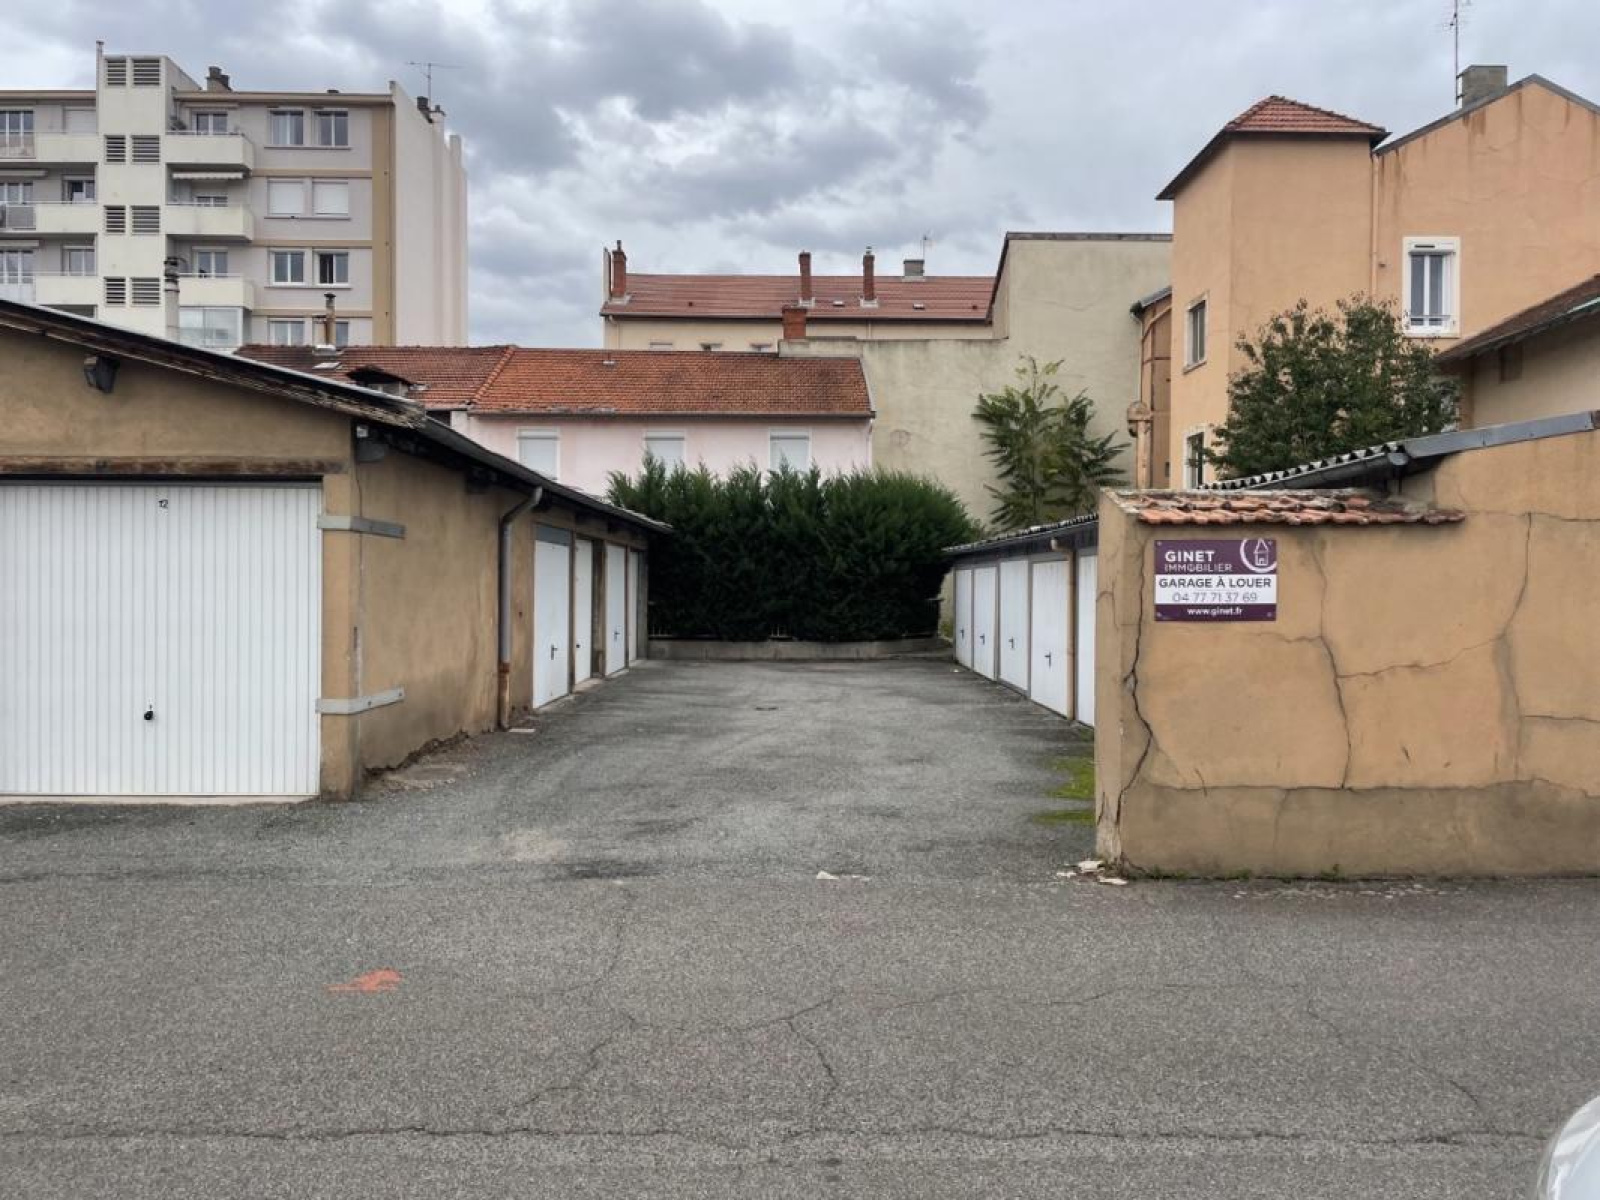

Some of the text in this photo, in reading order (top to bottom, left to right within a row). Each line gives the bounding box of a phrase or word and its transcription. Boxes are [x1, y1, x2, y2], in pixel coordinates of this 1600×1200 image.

[1165, 550, 1215, 562] GINET
[1164, 564, 1232, 572] IMMOBILIER
[1159, 576, 1271, 588] GARAGE À LOUER
[1172, 592, 1189, 602] 04
[1193, 592, 1206, 602] 77
[1225, 592, 1239, 602] 37
[1242, 592, 1258, 602] 69
[1187, 607, 1242, 616] www.ginet.fr
